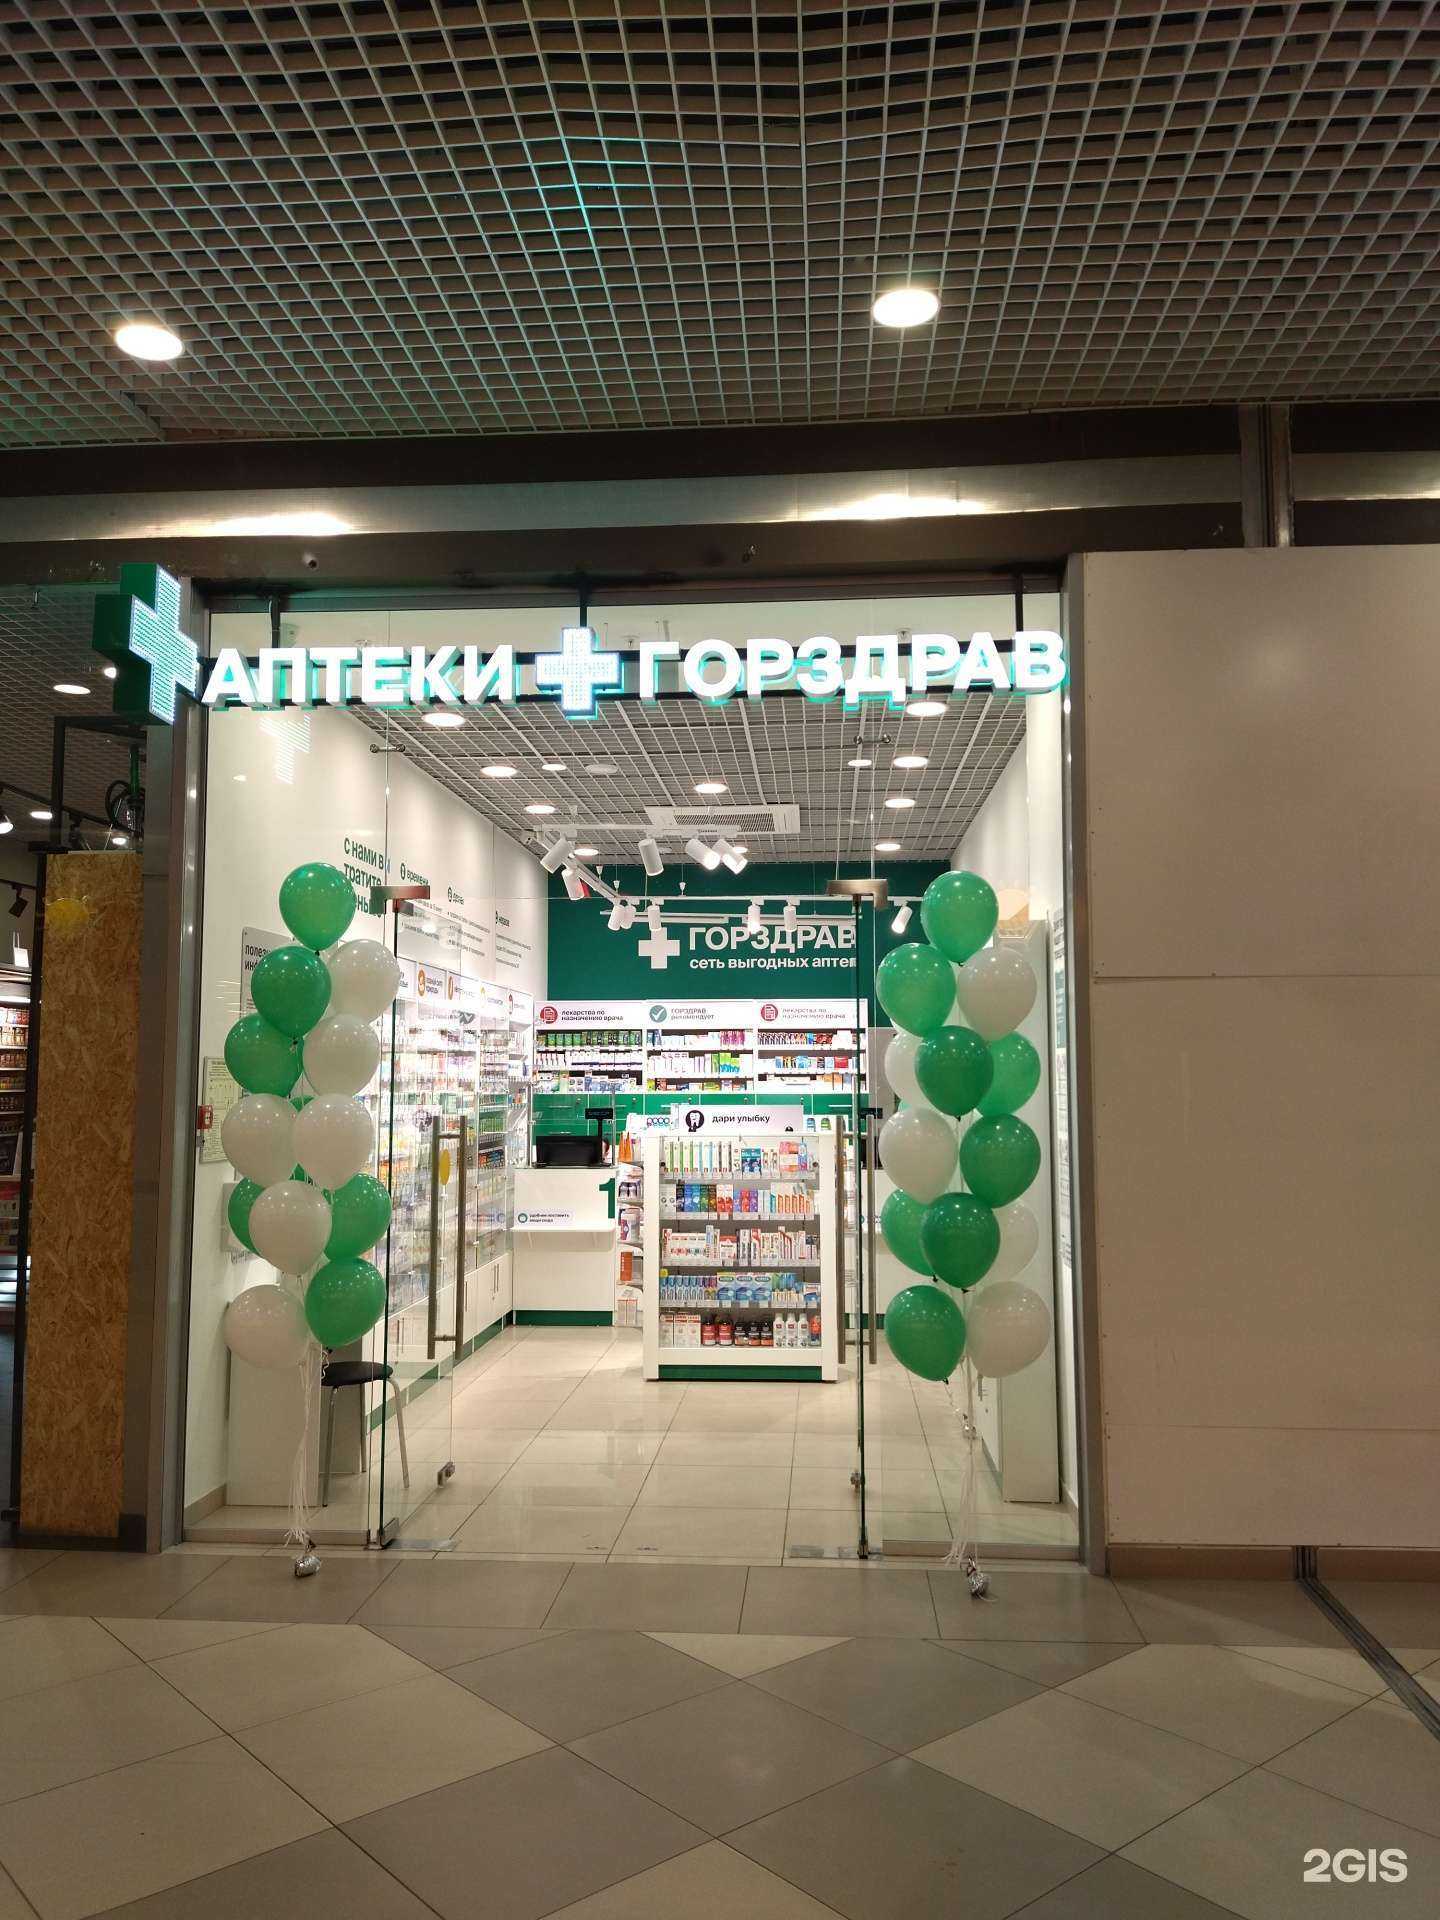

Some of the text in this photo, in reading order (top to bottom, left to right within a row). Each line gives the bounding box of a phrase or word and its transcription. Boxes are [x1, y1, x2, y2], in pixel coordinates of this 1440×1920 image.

[201, 630, 1066, 708] АПТЕКИ ГОРЗДРАВ
[344, 838, 350, 854] с
[352, 842, 376, 866] нами
[689, 926, 857, 953] ГОРЗДРАВ
[689, 957, 725, 969] сеть
[728, 957, 809, 970] выгодных
[712, 1113, 771, 1124] дари улыбку
[599, 1178, 615, 1219] 1
